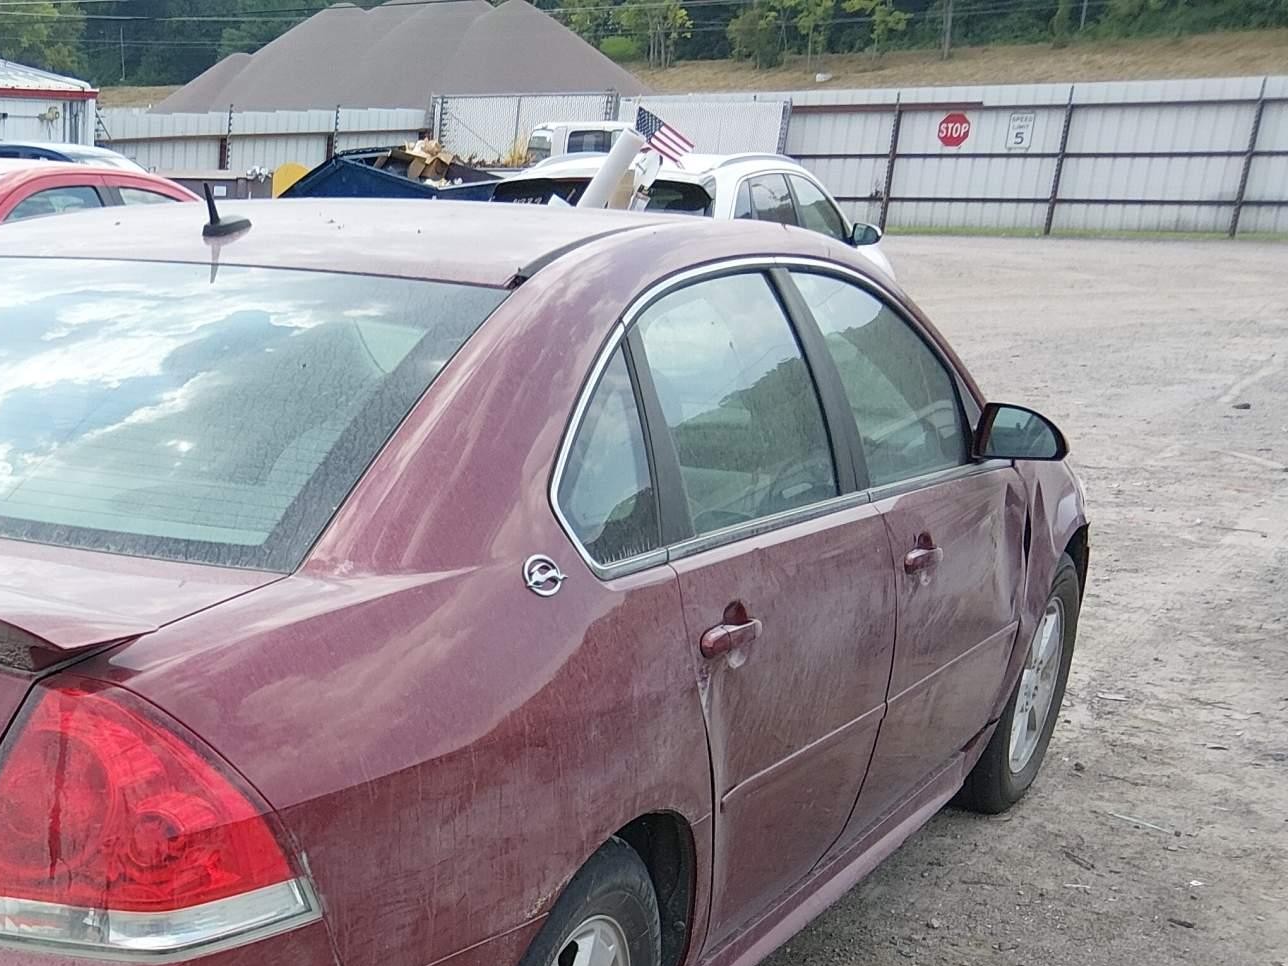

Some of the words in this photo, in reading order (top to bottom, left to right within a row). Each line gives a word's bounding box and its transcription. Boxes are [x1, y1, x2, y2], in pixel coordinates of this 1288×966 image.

[1012, 115, 1033, 123] SPEED
[939, 123, 970, 138] STOP
[1014, 132, 1024, 144] 5
